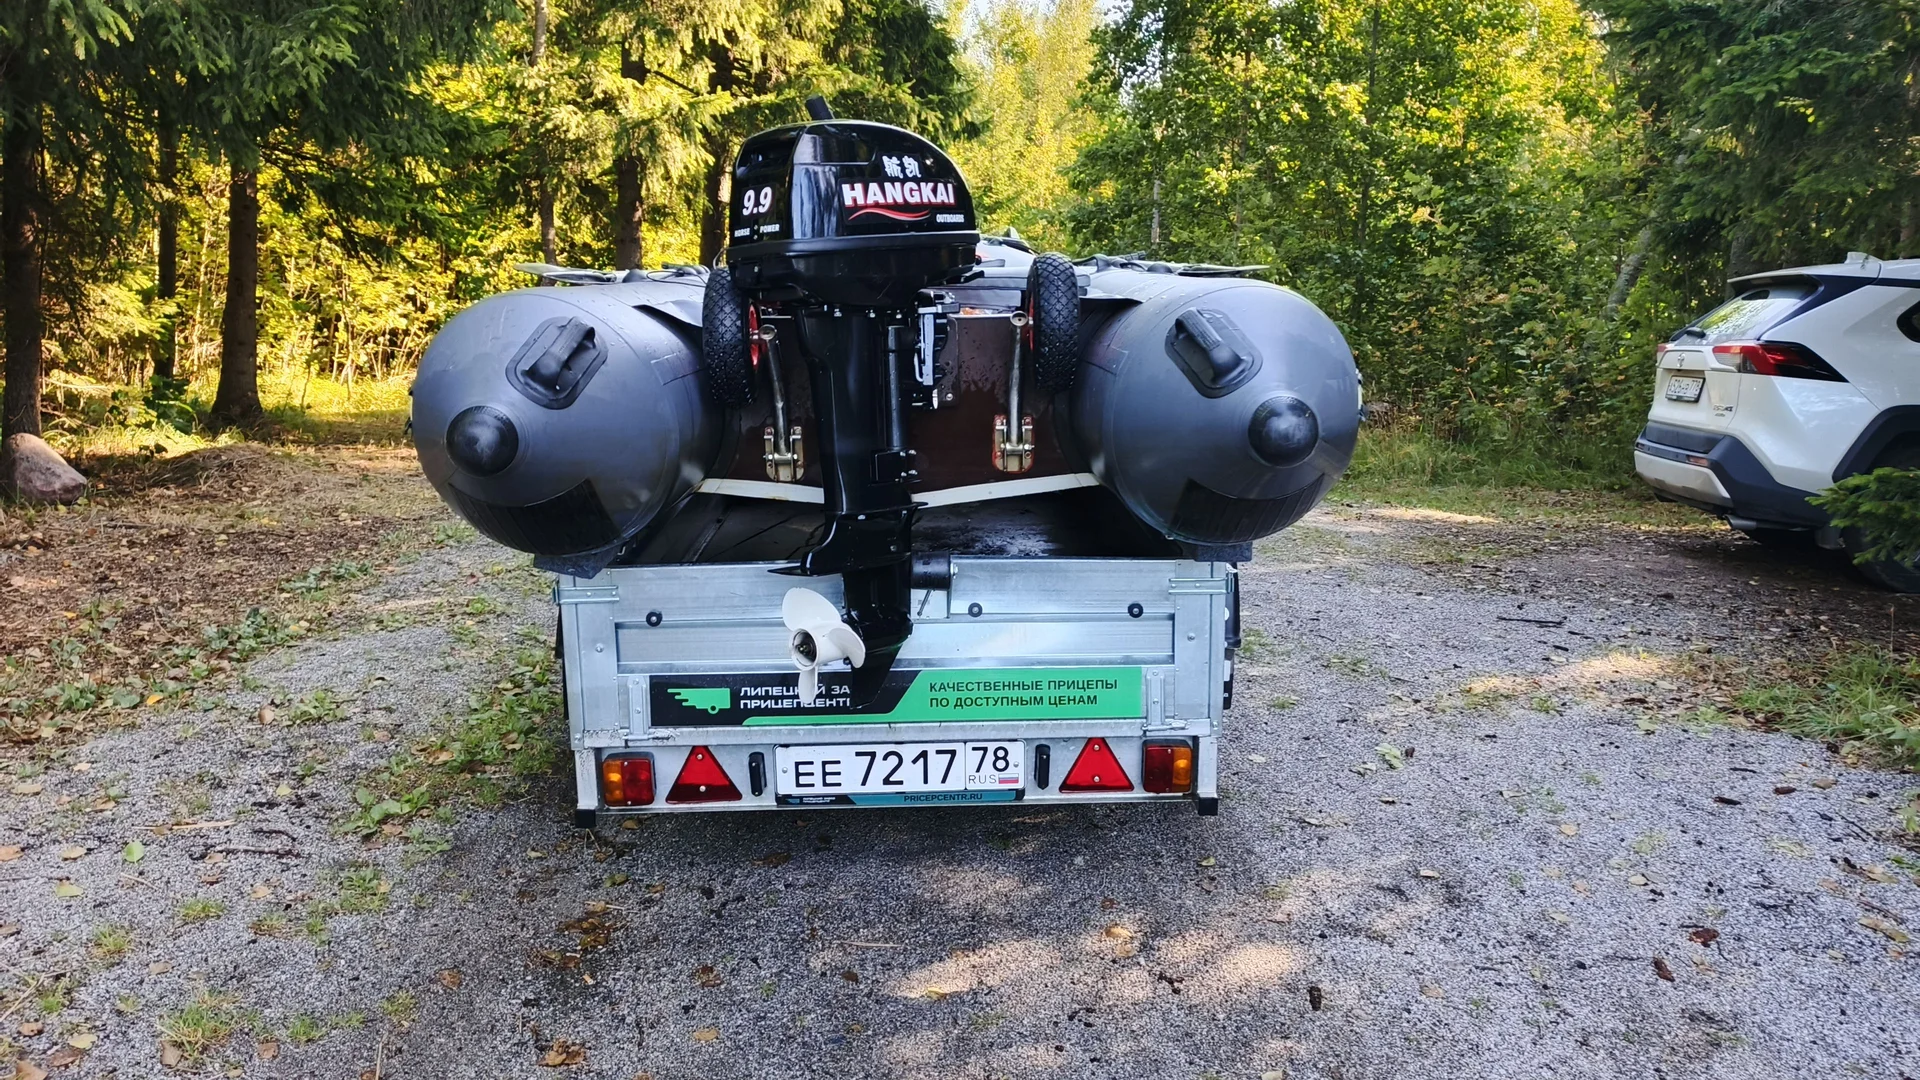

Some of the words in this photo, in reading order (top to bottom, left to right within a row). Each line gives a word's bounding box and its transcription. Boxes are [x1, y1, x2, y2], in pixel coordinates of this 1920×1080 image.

[742, 186, 773, 216] 9.9
[841, 182, 956, 206] HANGKAI
[734, 227, 750, 238] HORSE
[759, 223, 780, 234] POWER
[740, 684, 826, 696] ЛИПЕЦЙ
[929, 680, 1043, 693] КАЧЕСТВЕННЫЕ
[1047, 679, 1118, 692] ПРИЦЕПЫ
[929, 697, 950, 708] ПО
[953, 696, 1044, 710] ДОСТУПНЫМ
[1048, 695, 1098, 708] ЦЕНАМ
[855, 749, 957, 787] 7217
[971, 746, 1010, 773] 78
[968, 774, 997, 785] RUS
[903, 793, 983, 803] PRICEPCENTR.RU
